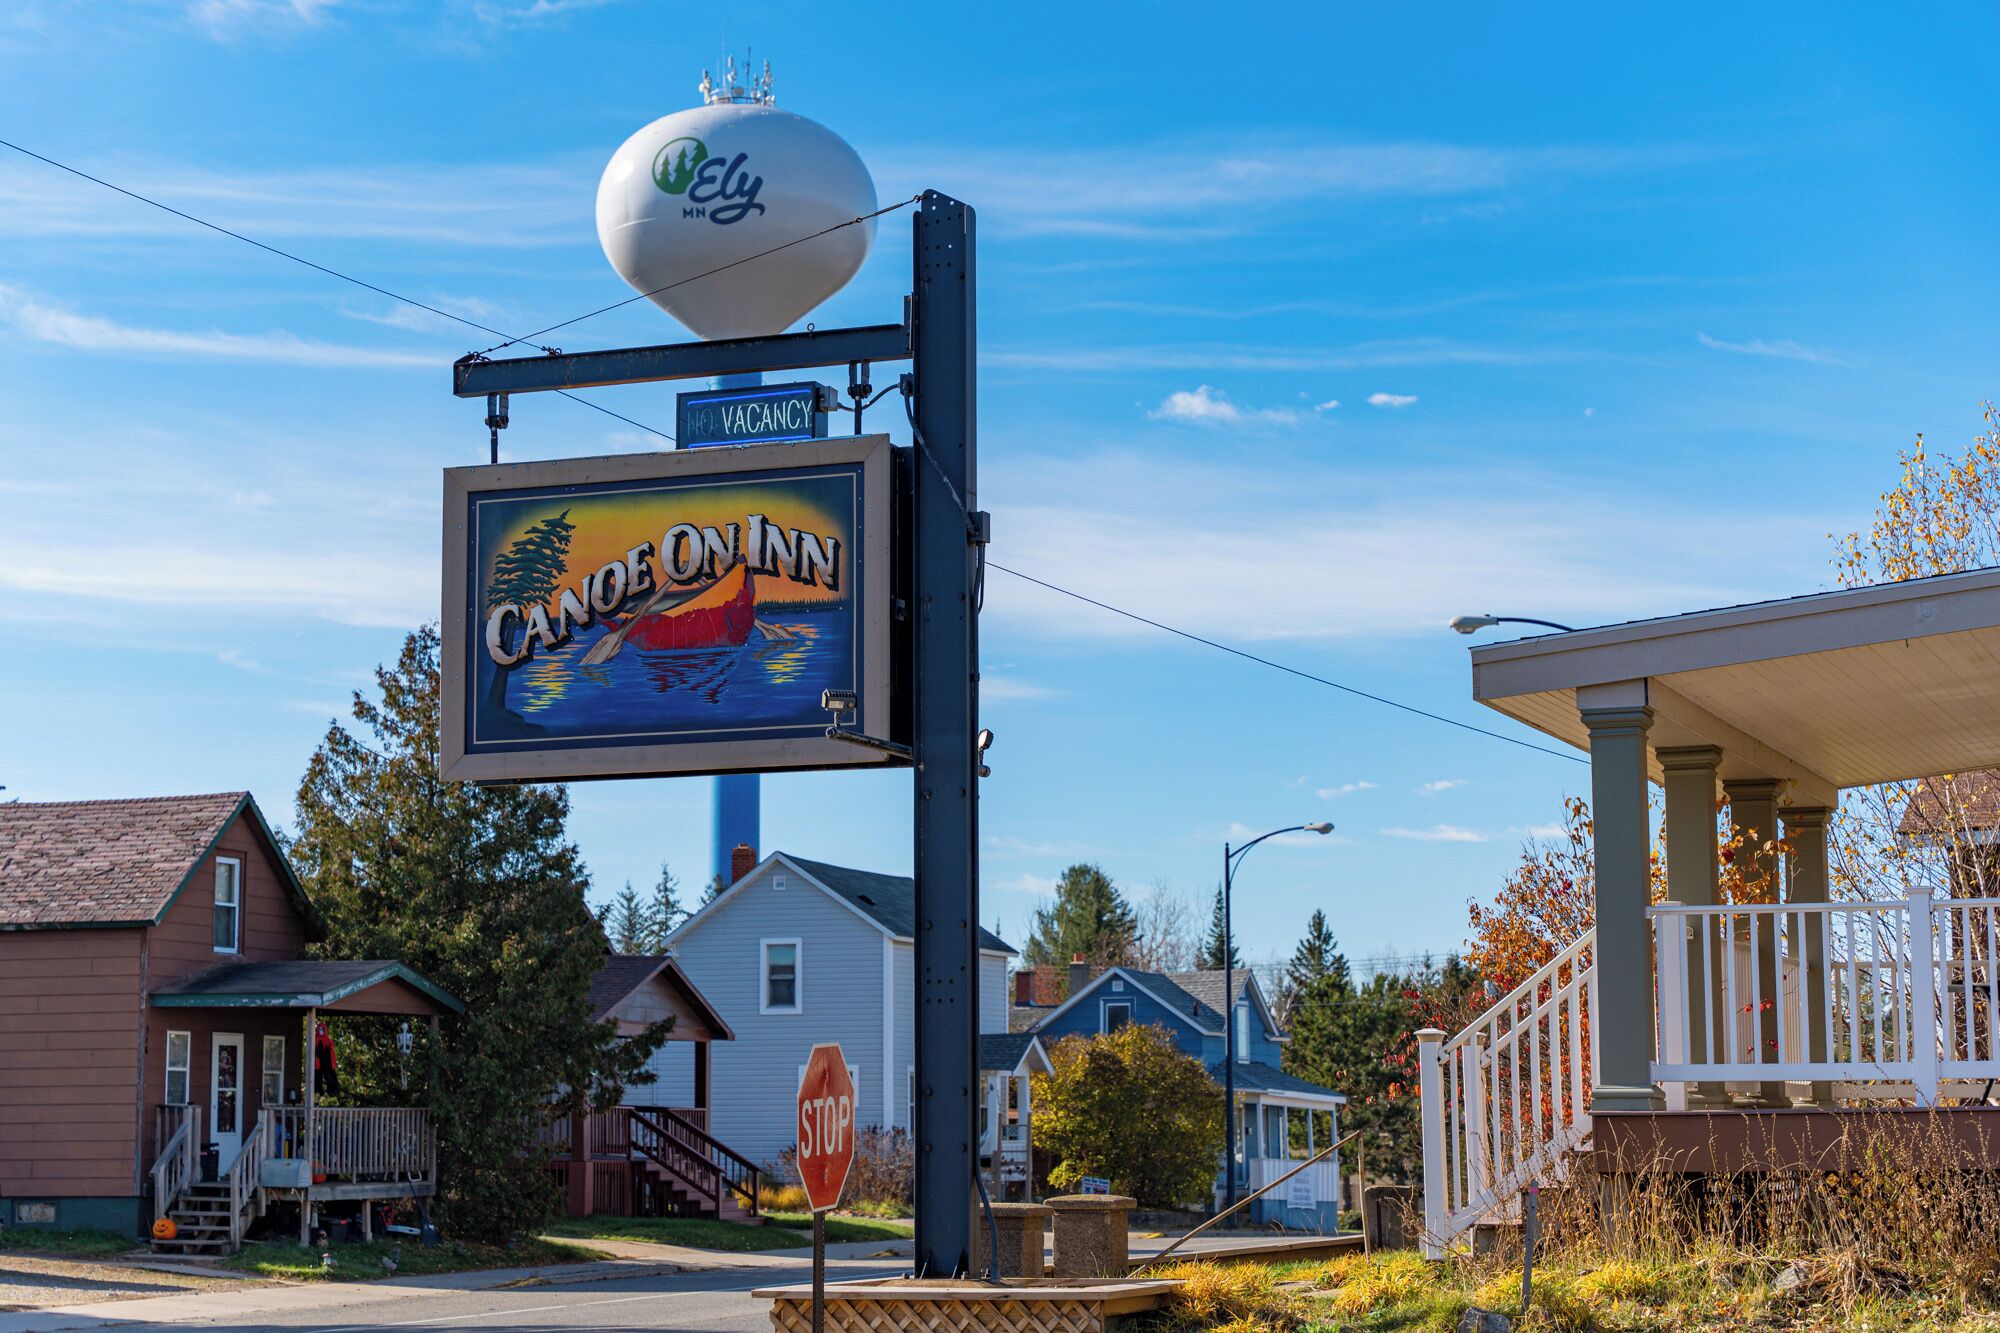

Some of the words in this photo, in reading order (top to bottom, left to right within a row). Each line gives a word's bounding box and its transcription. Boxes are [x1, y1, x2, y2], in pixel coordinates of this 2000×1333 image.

[682, 208, 706, 219] MN
[689, 152, 765, 225] Ely
[687, 408, 714, 437] NO
[722, 400, 813, 434] VACANCY
[486, 542, 655, 667] CANOE
[661, 523, 740, 584] ON
[747, 514, 841, 592] INN
[802, 1096, 850, 1159] STOP
